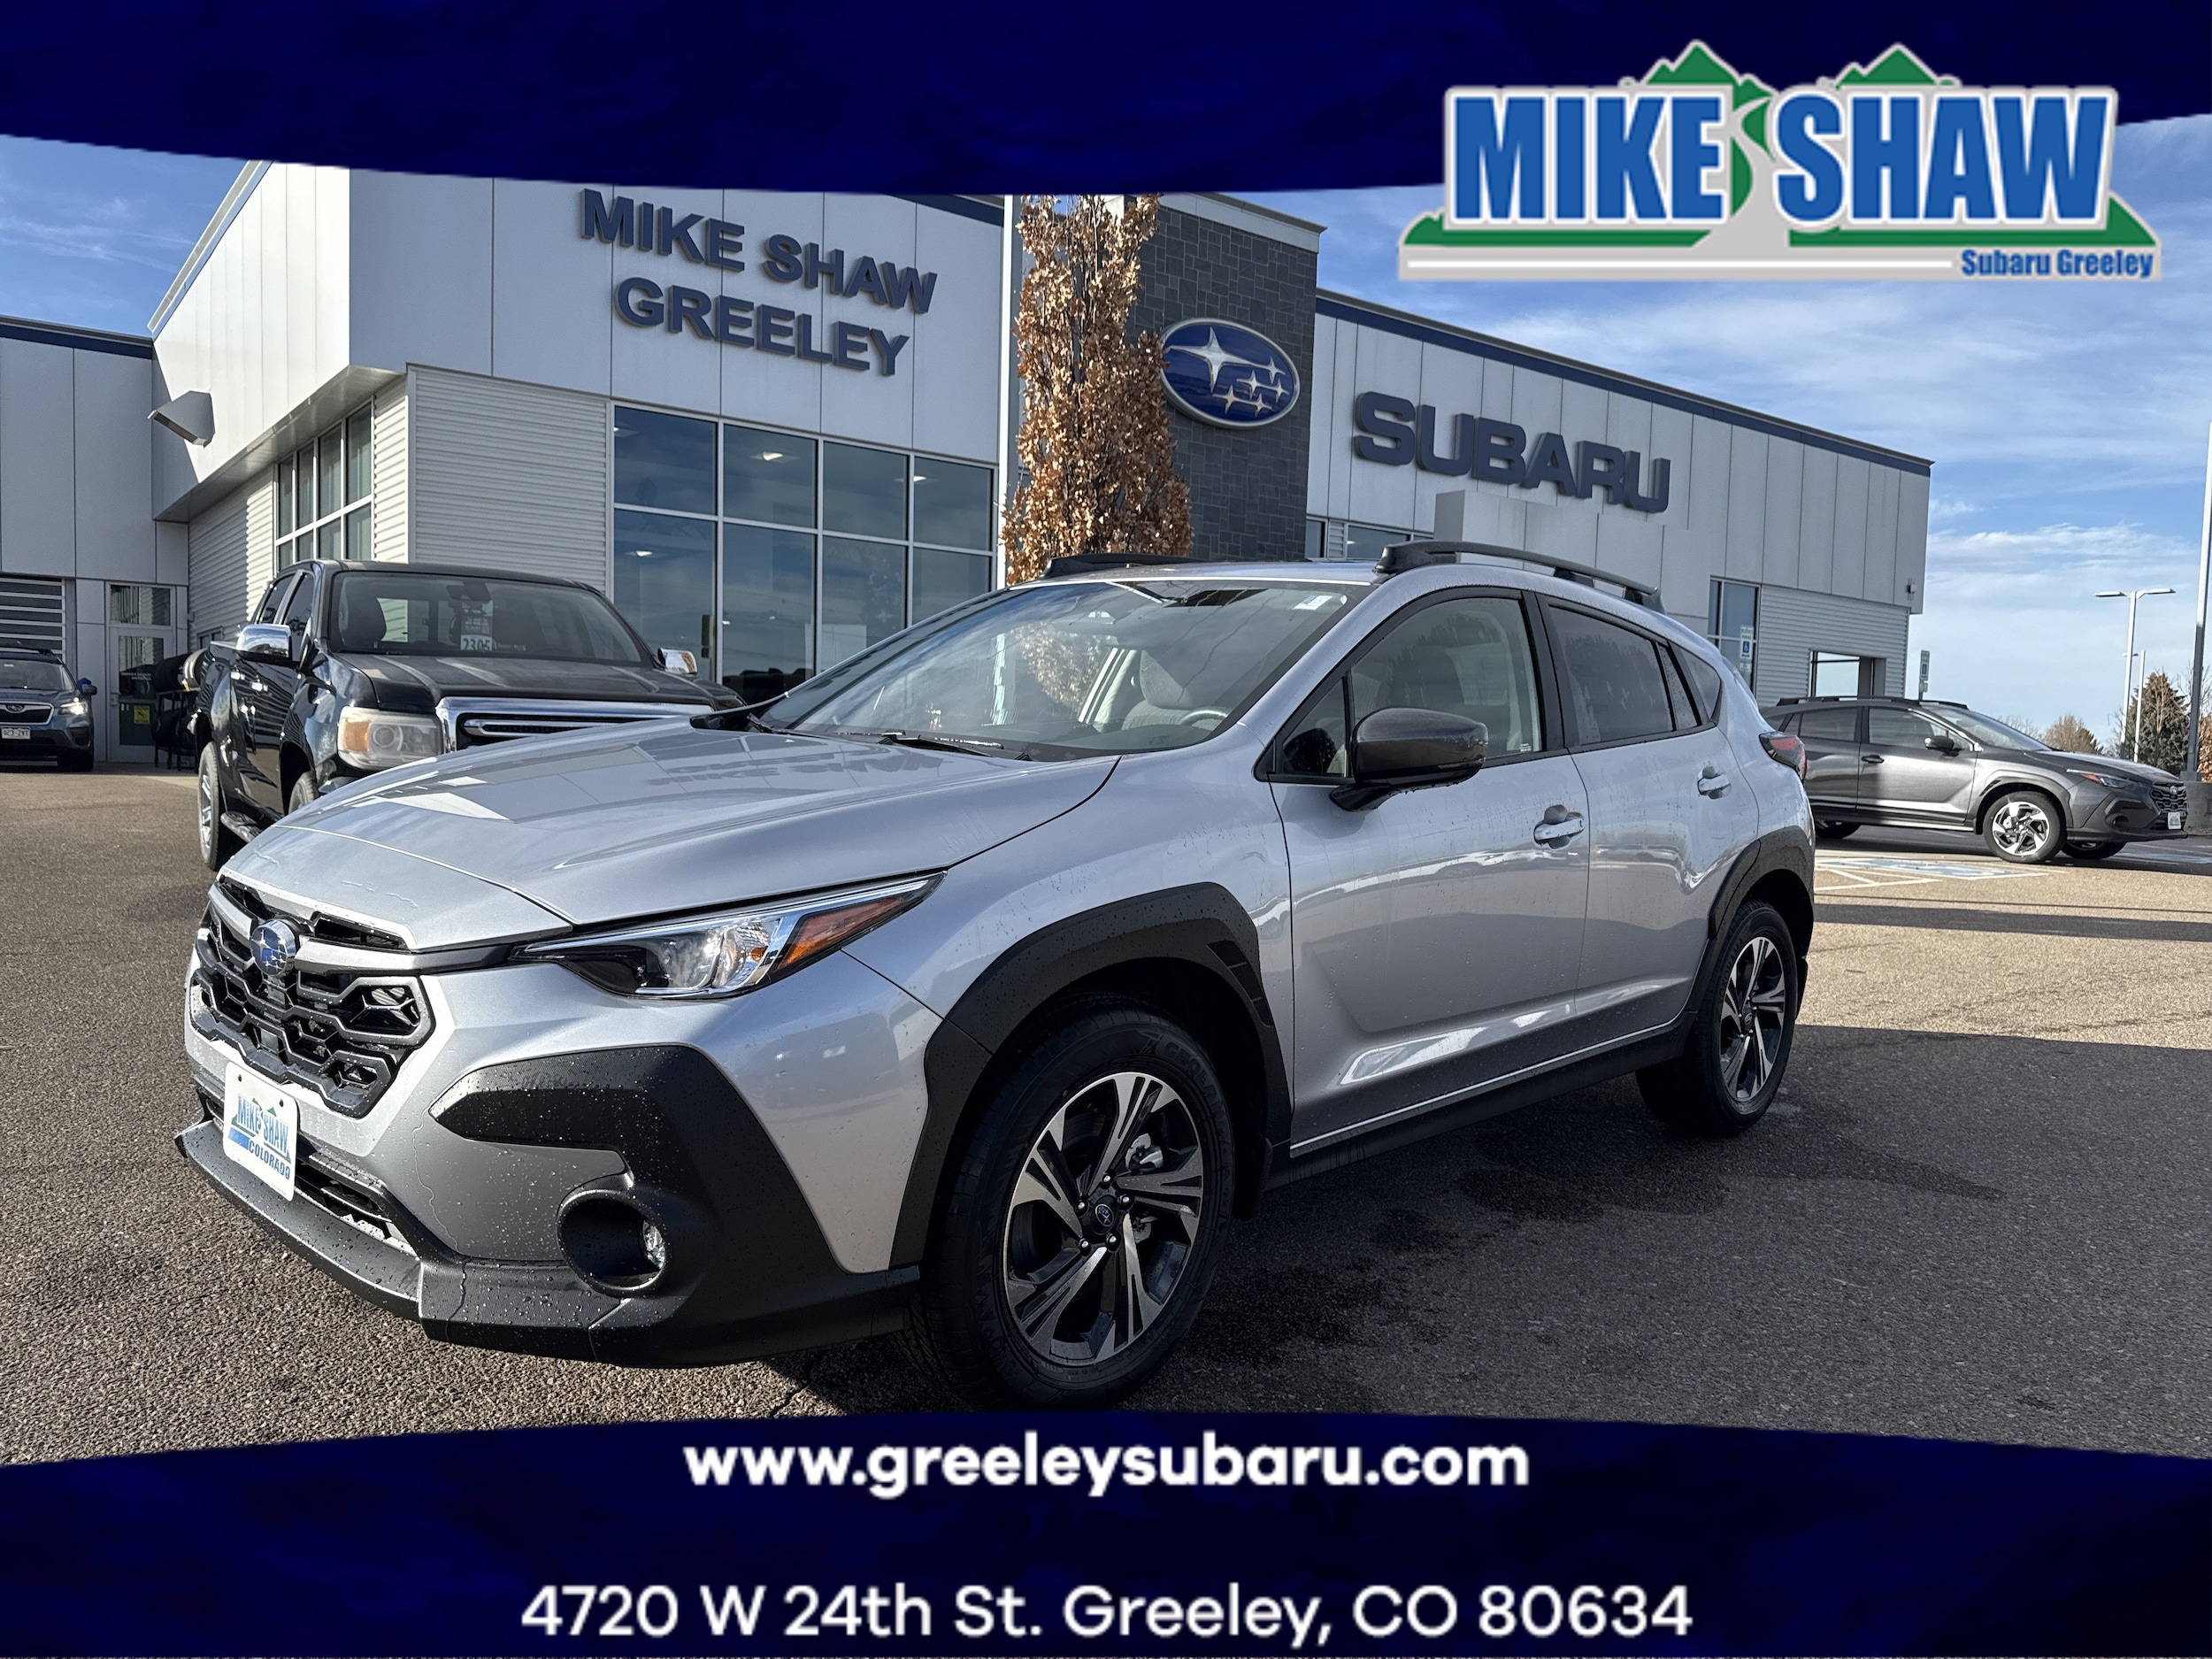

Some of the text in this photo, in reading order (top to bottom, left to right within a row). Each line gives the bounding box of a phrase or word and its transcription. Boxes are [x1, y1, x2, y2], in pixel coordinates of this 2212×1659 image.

[580, 188, 938, 313] MIKE SHAW
[615, 277, 910, 376] GREELEY
[1354, 391, 1671, 513] SUBARU
[236, 1094, 260, 1135] MIKE
[263, 1110, 289, 1154] SHAW
[249, 1140, 292, 1180] COLORADO
